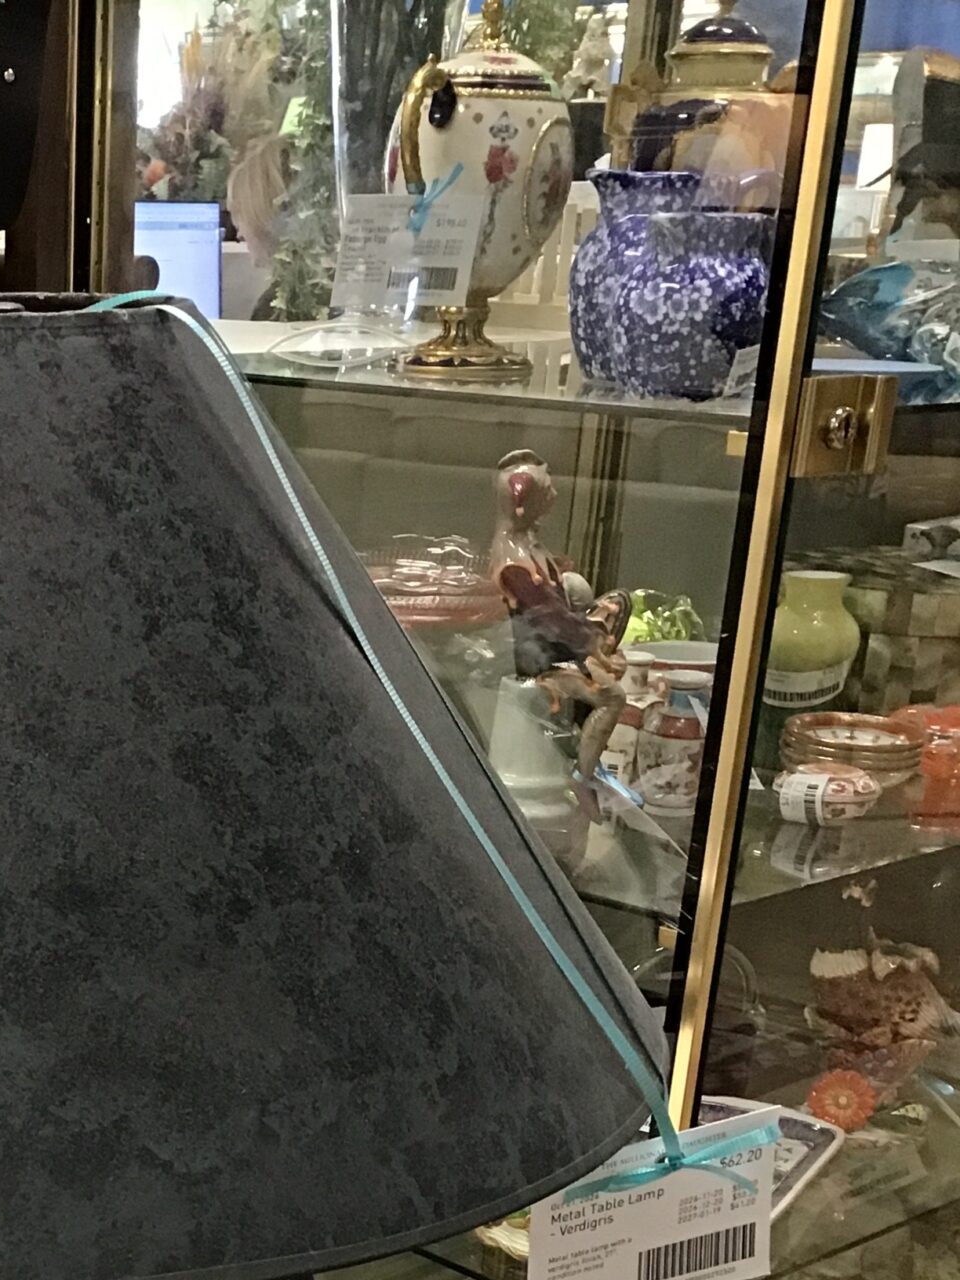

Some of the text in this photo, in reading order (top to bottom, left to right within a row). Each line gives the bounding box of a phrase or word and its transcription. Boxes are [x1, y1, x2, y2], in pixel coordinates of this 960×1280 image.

[720, 1148, 763, 1169] $62.20
[551, 1188, 665, 1225] Metal Table Lamp
[560, 1215, 614, 1236] Verdigris
